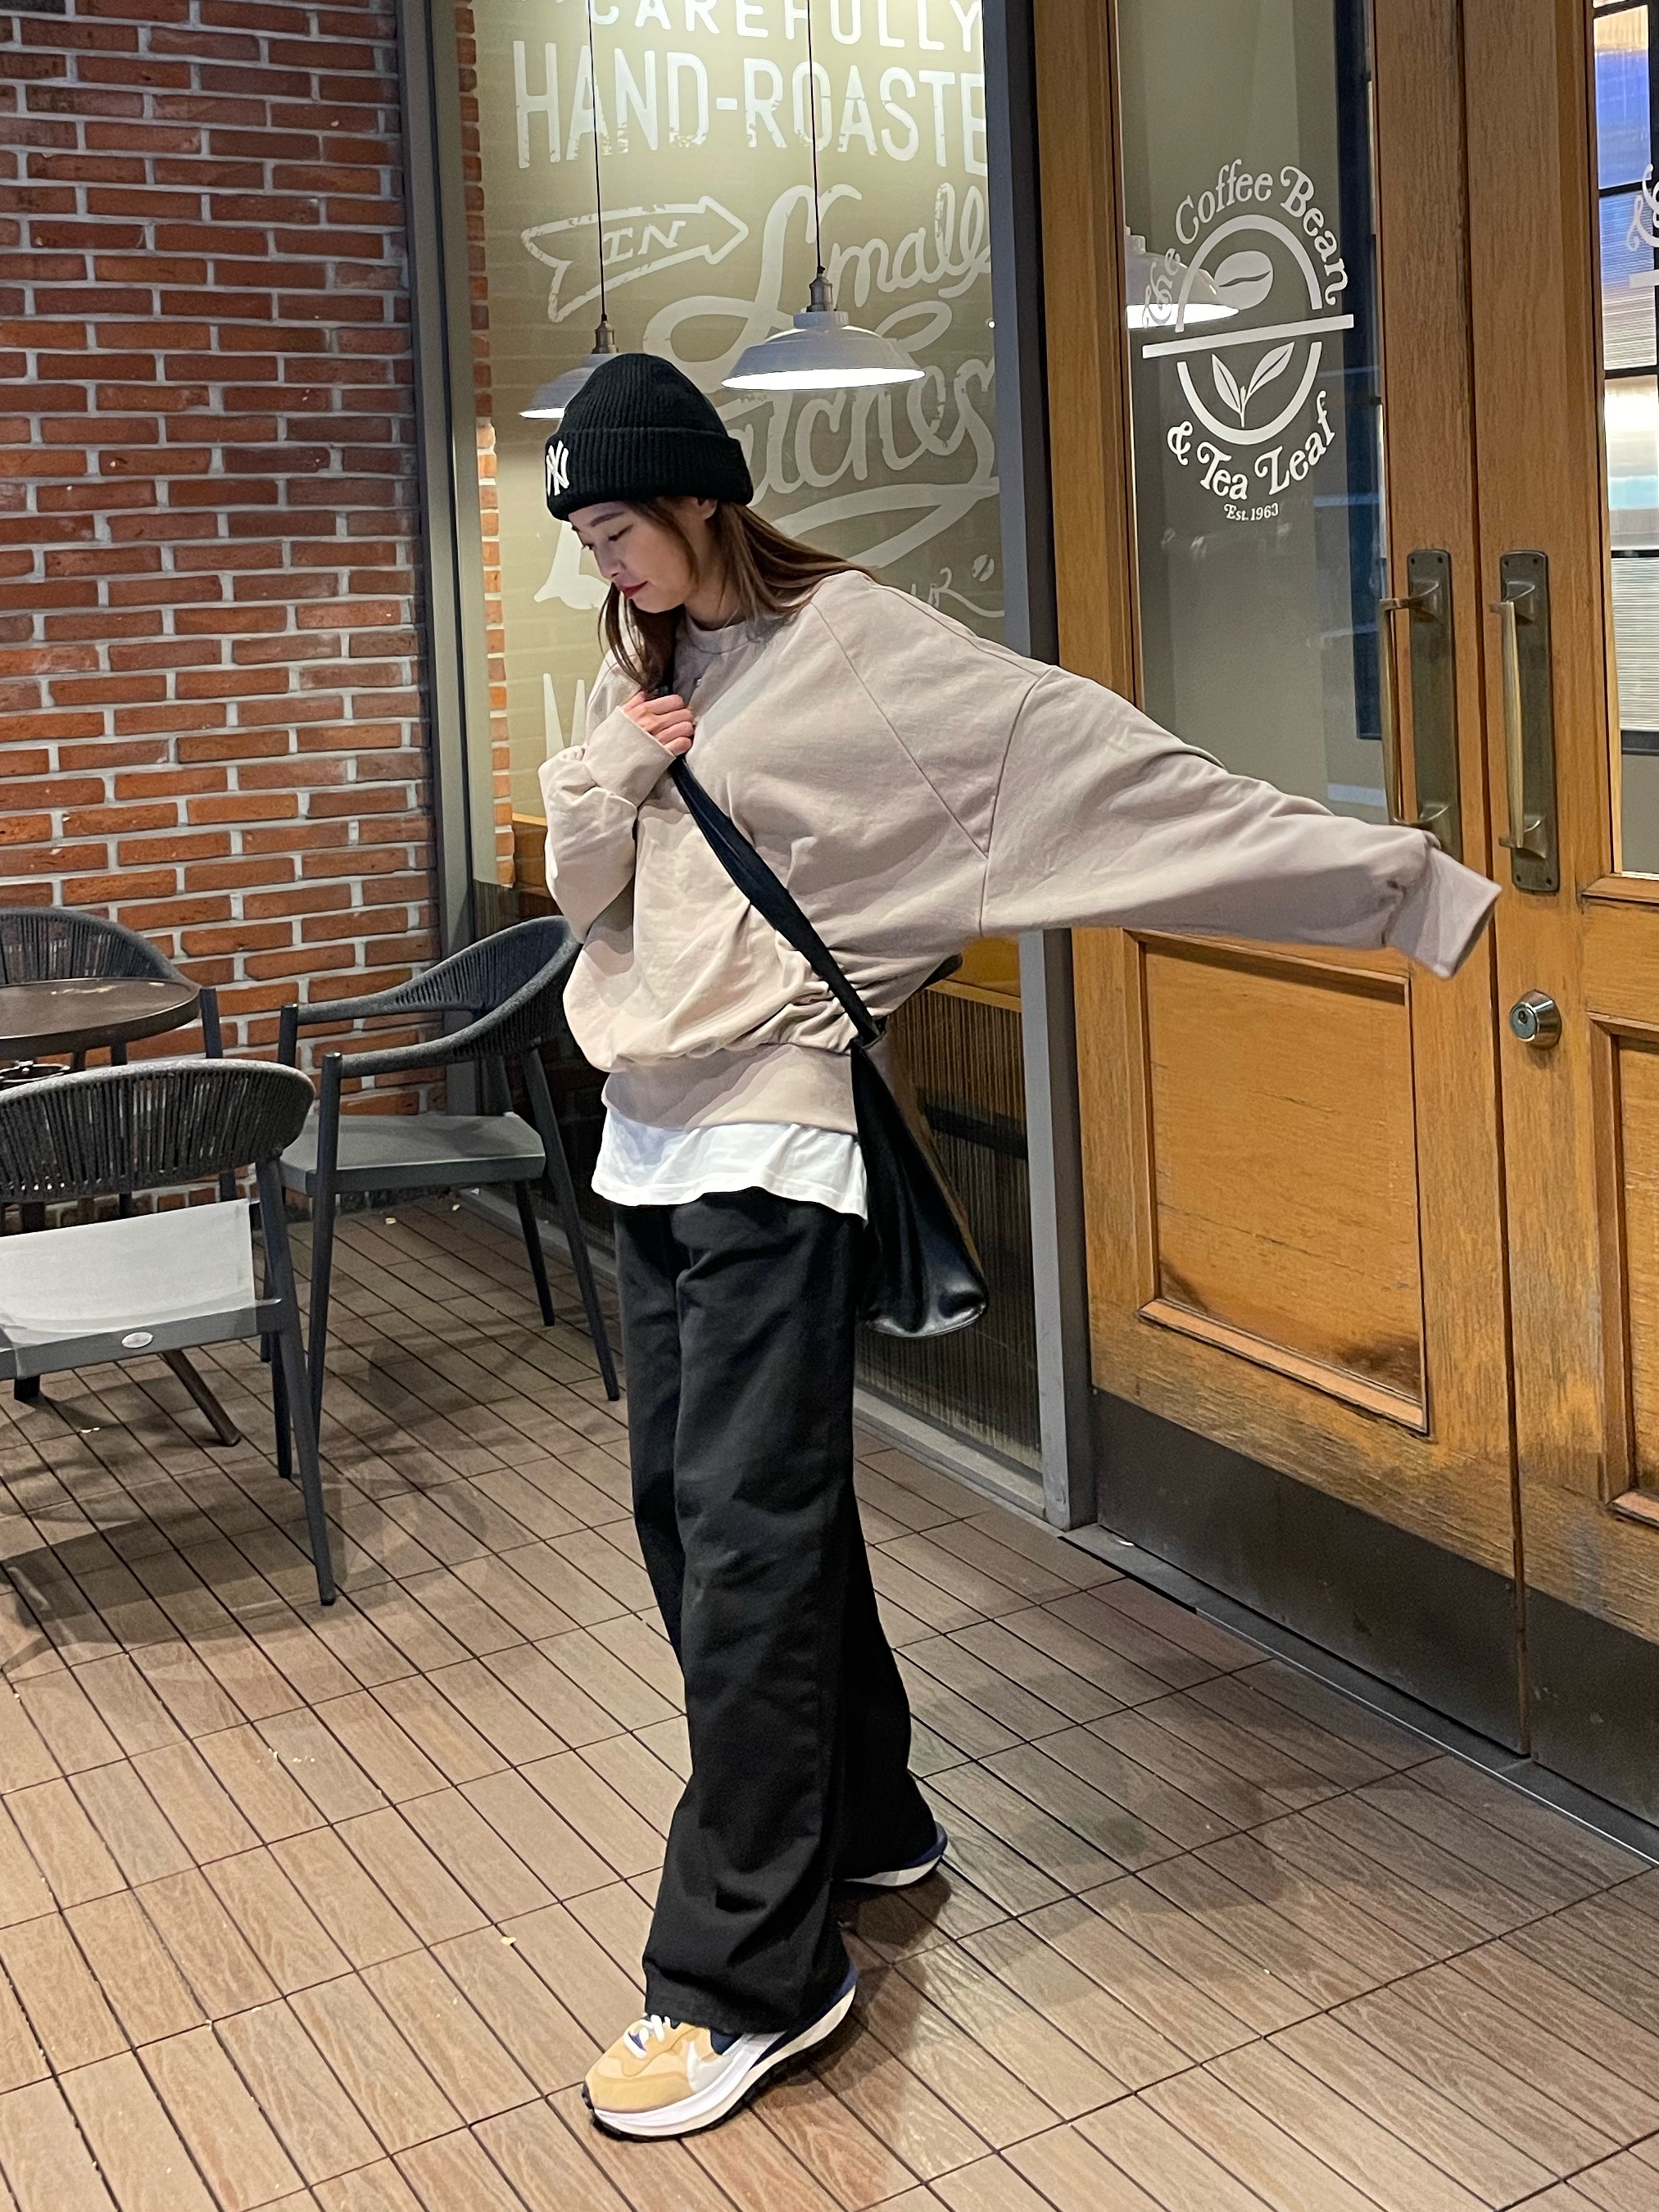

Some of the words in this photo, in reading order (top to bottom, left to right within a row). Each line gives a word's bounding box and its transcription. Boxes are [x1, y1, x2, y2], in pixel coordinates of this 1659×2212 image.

[602, 220, 687, 266] IN
[1175, 158, 1273, 244] Coffee
[1280, 165, 1349, 306] Bean
[546, 440, 570, 497] NY
[1167, 420, 1194, 466] &
[1196, 441, 1249, 501] Tea
[1253, 390, 1335, 496] Leaf
